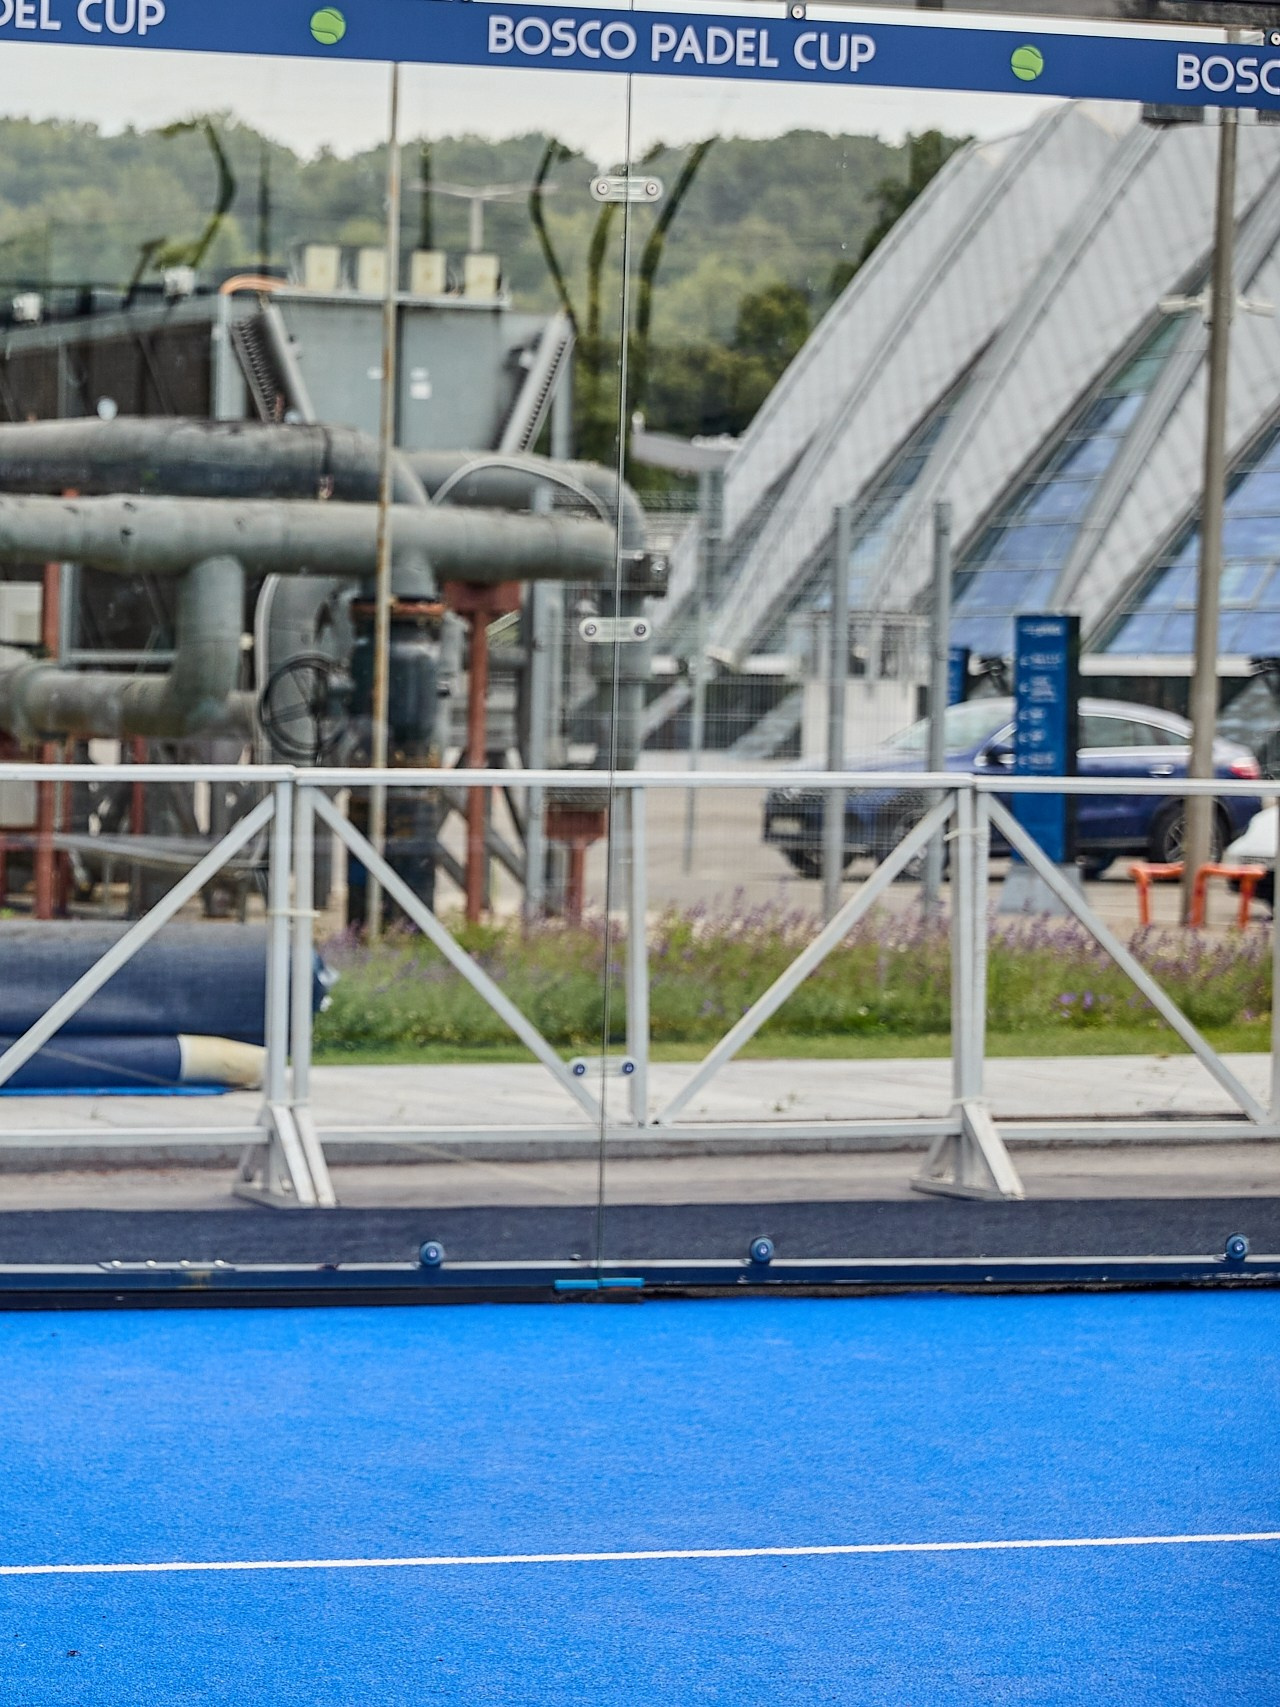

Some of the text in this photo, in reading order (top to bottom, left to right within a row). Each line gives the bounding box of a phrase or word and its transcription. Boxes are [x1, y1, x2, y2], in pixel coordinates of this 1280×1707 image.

[77, 0, 166, 36] CUP
[488, 14, 876, 72] BOSCO PADEL CUP
[1176, 52, 1280, 95] BOSC
